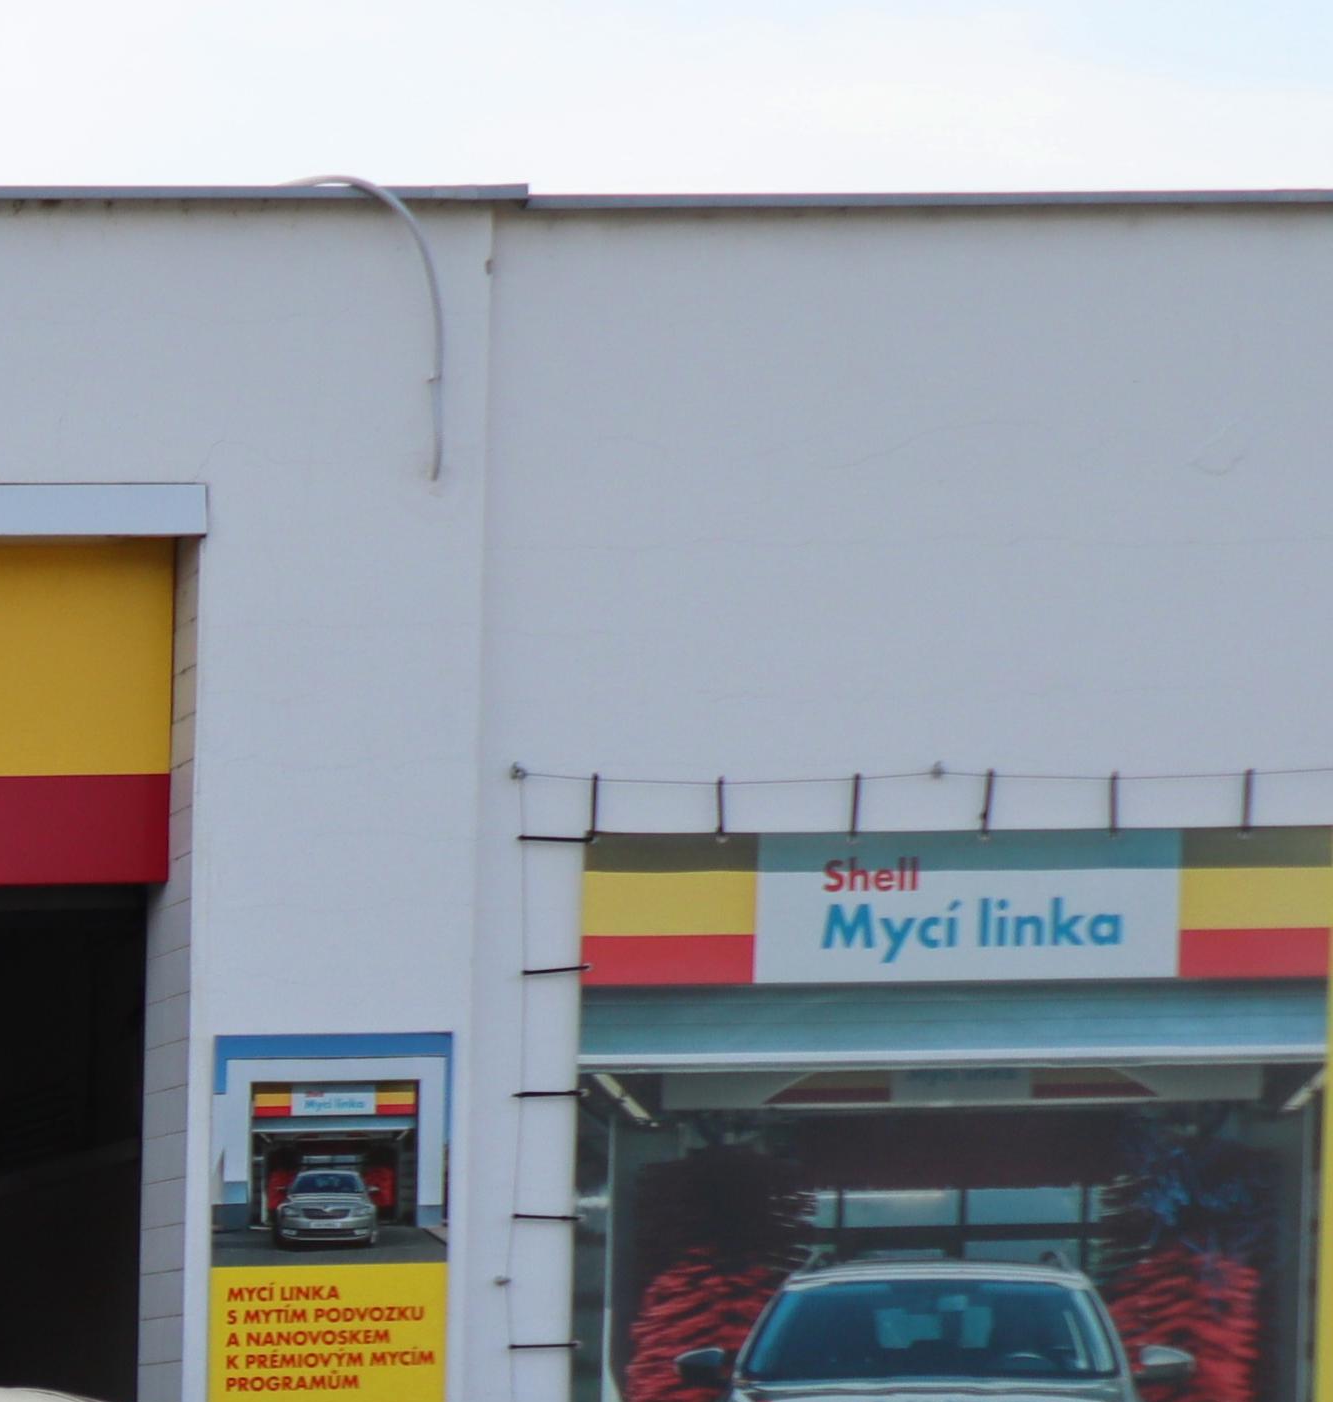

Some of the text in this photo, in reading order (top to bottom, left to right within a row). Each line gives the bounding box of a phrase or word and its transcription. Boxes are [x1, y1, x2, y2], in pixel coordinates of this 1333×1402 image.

[821, 856, 920, 892] Shell
[820, 897, 1124, 964] Mycí linka
[227, 1282, 340, 1302] MYCÍ LINKA
[227, 1304, 425, 1325] S MYTÍM PODVOZKU
[225, 1329, 391, 1347] A NANOVOSKEM
[226, 1346, 436, 1369] K PRÉMIOVÝM MYCÍM
[225, 1370, 360, 1392] PROGRAMŮM
